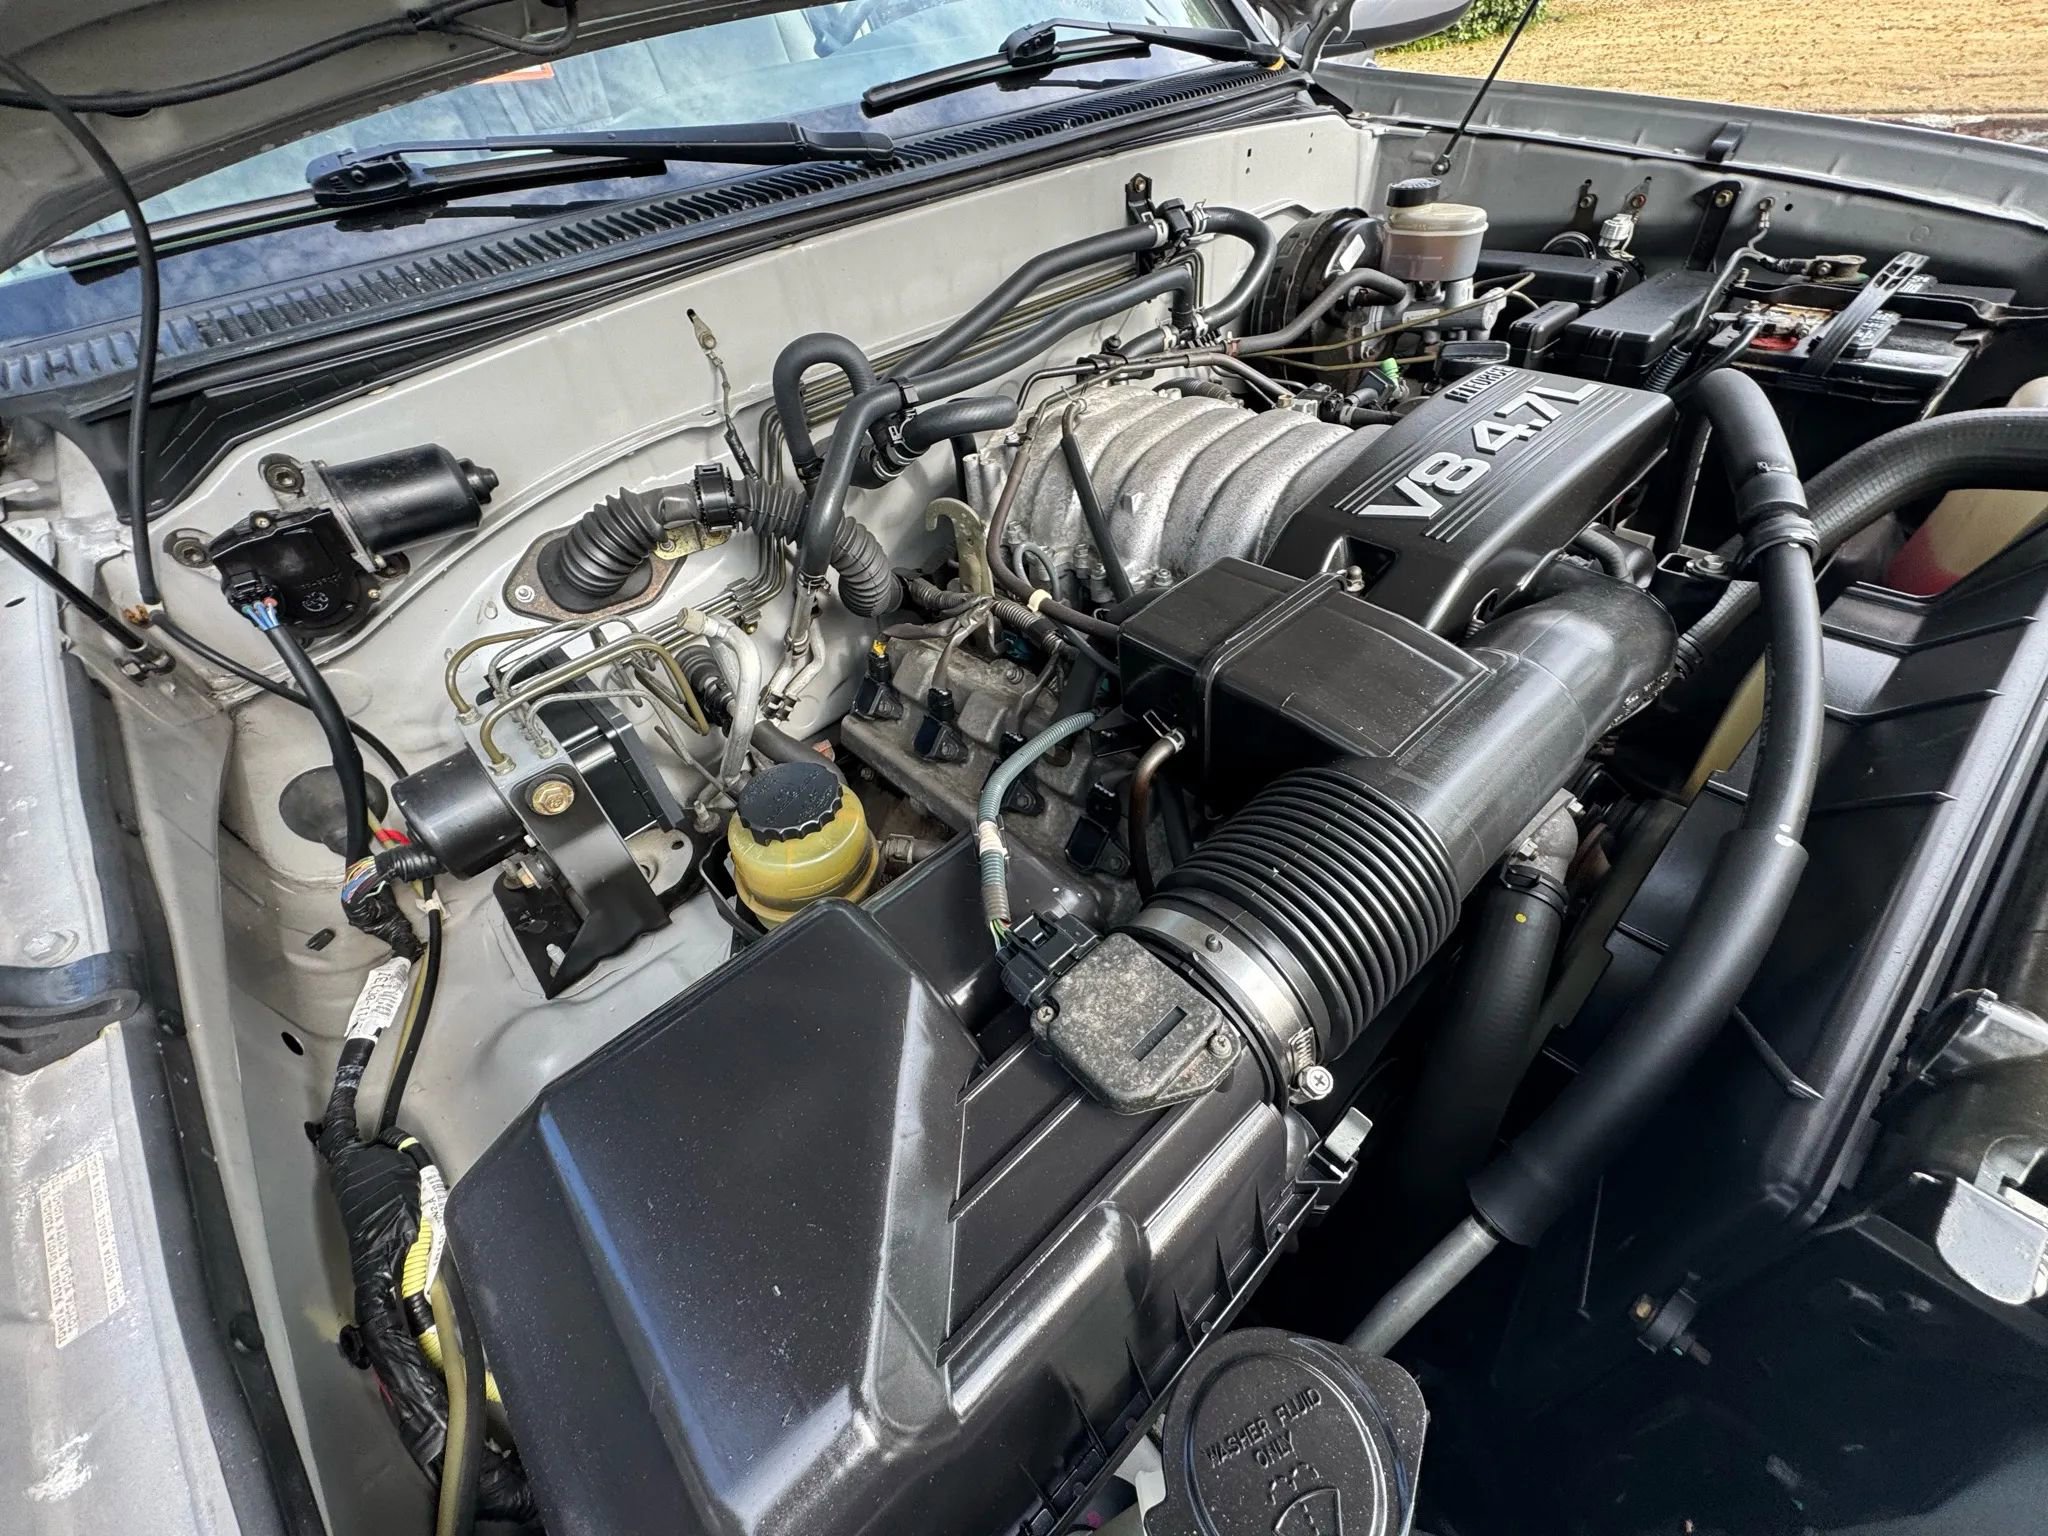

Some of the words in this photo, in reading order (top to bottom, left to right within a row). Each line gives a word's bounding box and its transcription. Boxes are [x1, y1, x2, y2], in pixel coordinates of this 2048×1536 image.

[1357, 451, 1491, 519] V8
[1471, 383, 1603, 456] 4.7L
[1205, 1418, 1272, 1468] WASHER
[1274, 1388, 1322, 1427] FLUID
[1256, 1431, 1295, 1469] ONLY
